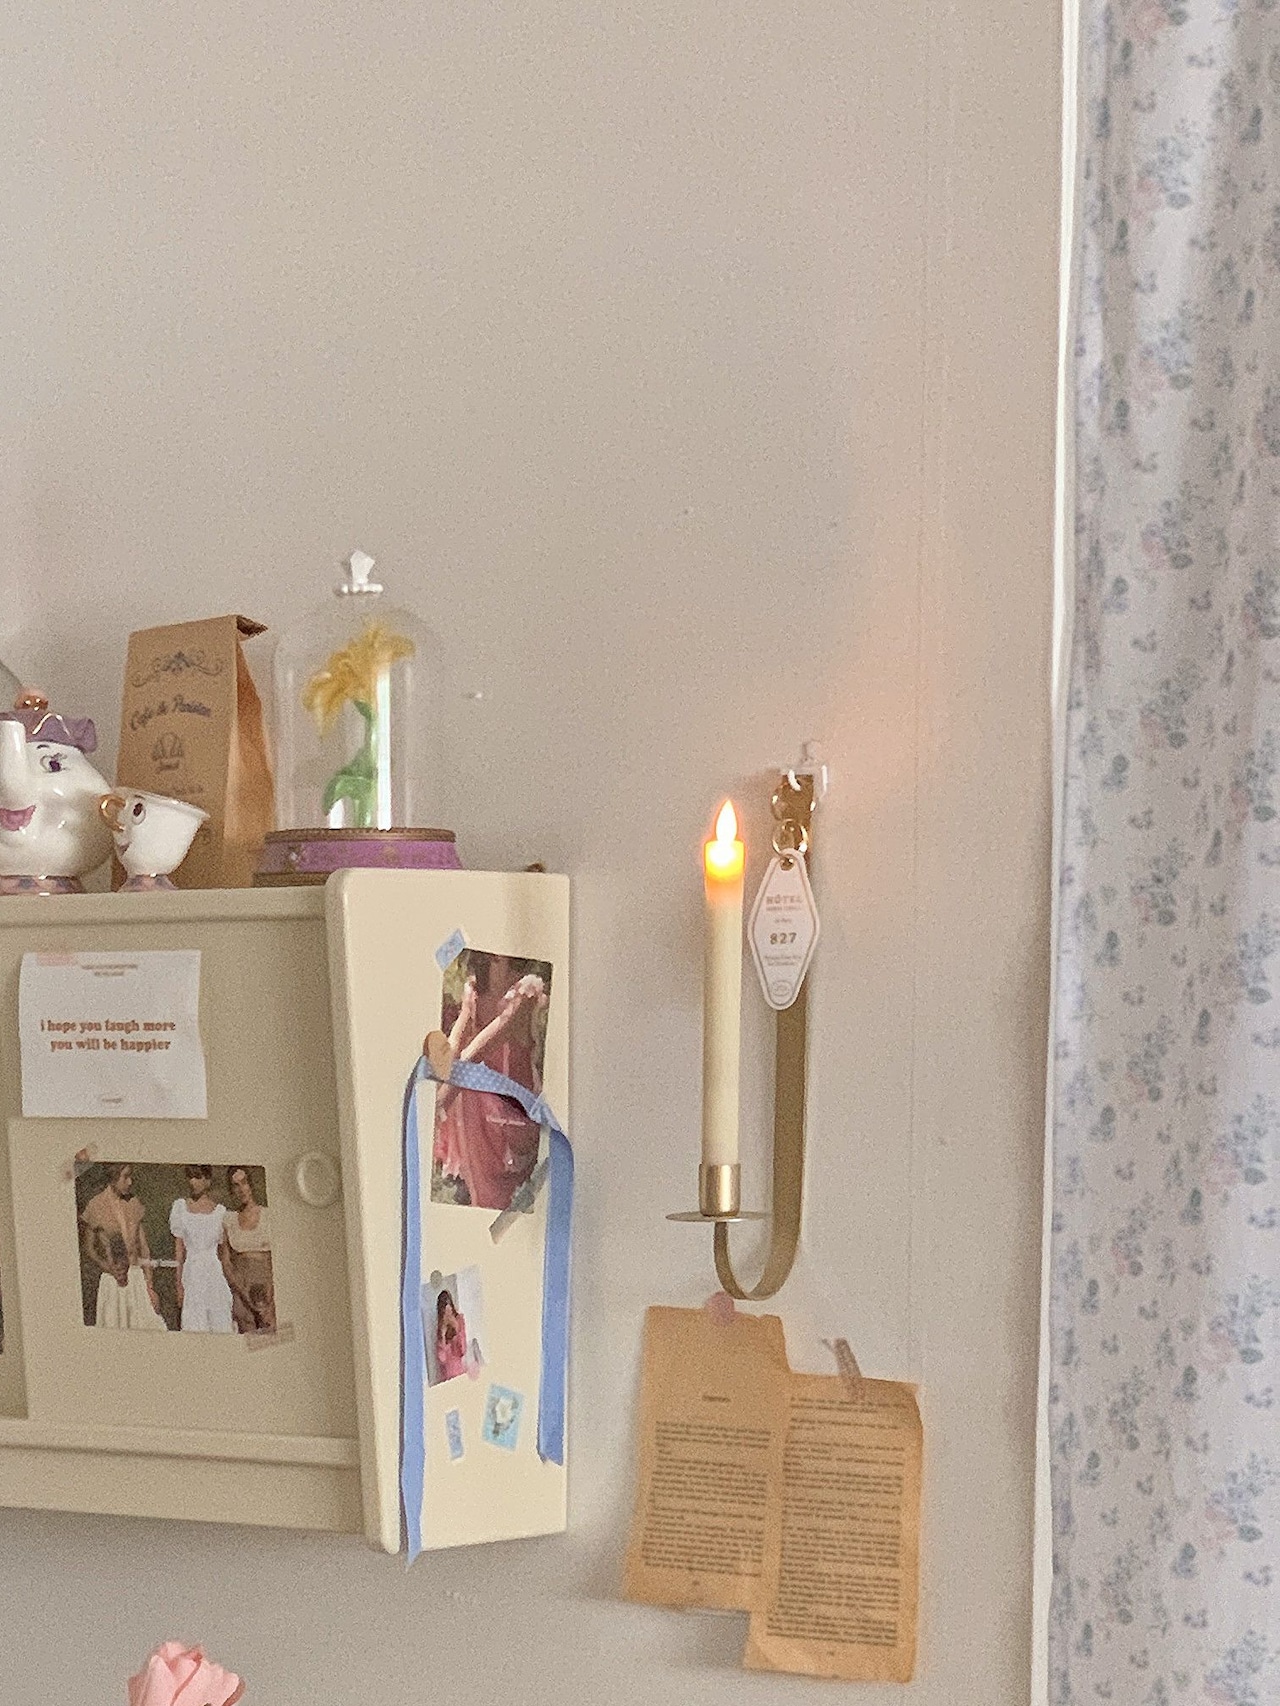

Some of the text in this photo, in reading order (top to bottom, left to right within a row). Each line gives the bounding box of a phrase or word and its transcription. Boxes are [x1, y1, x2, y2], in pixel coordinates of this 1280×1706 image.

[769, 932, 797, 945] 827
[47, 1019, 77, 1034] hope
[79, 1021, 102, 1034] you
[104, 1019, 140, 1035] laugh
[143, 1020, 176, 1032] more
[50, 1038, 172, 1053] you will be happier
